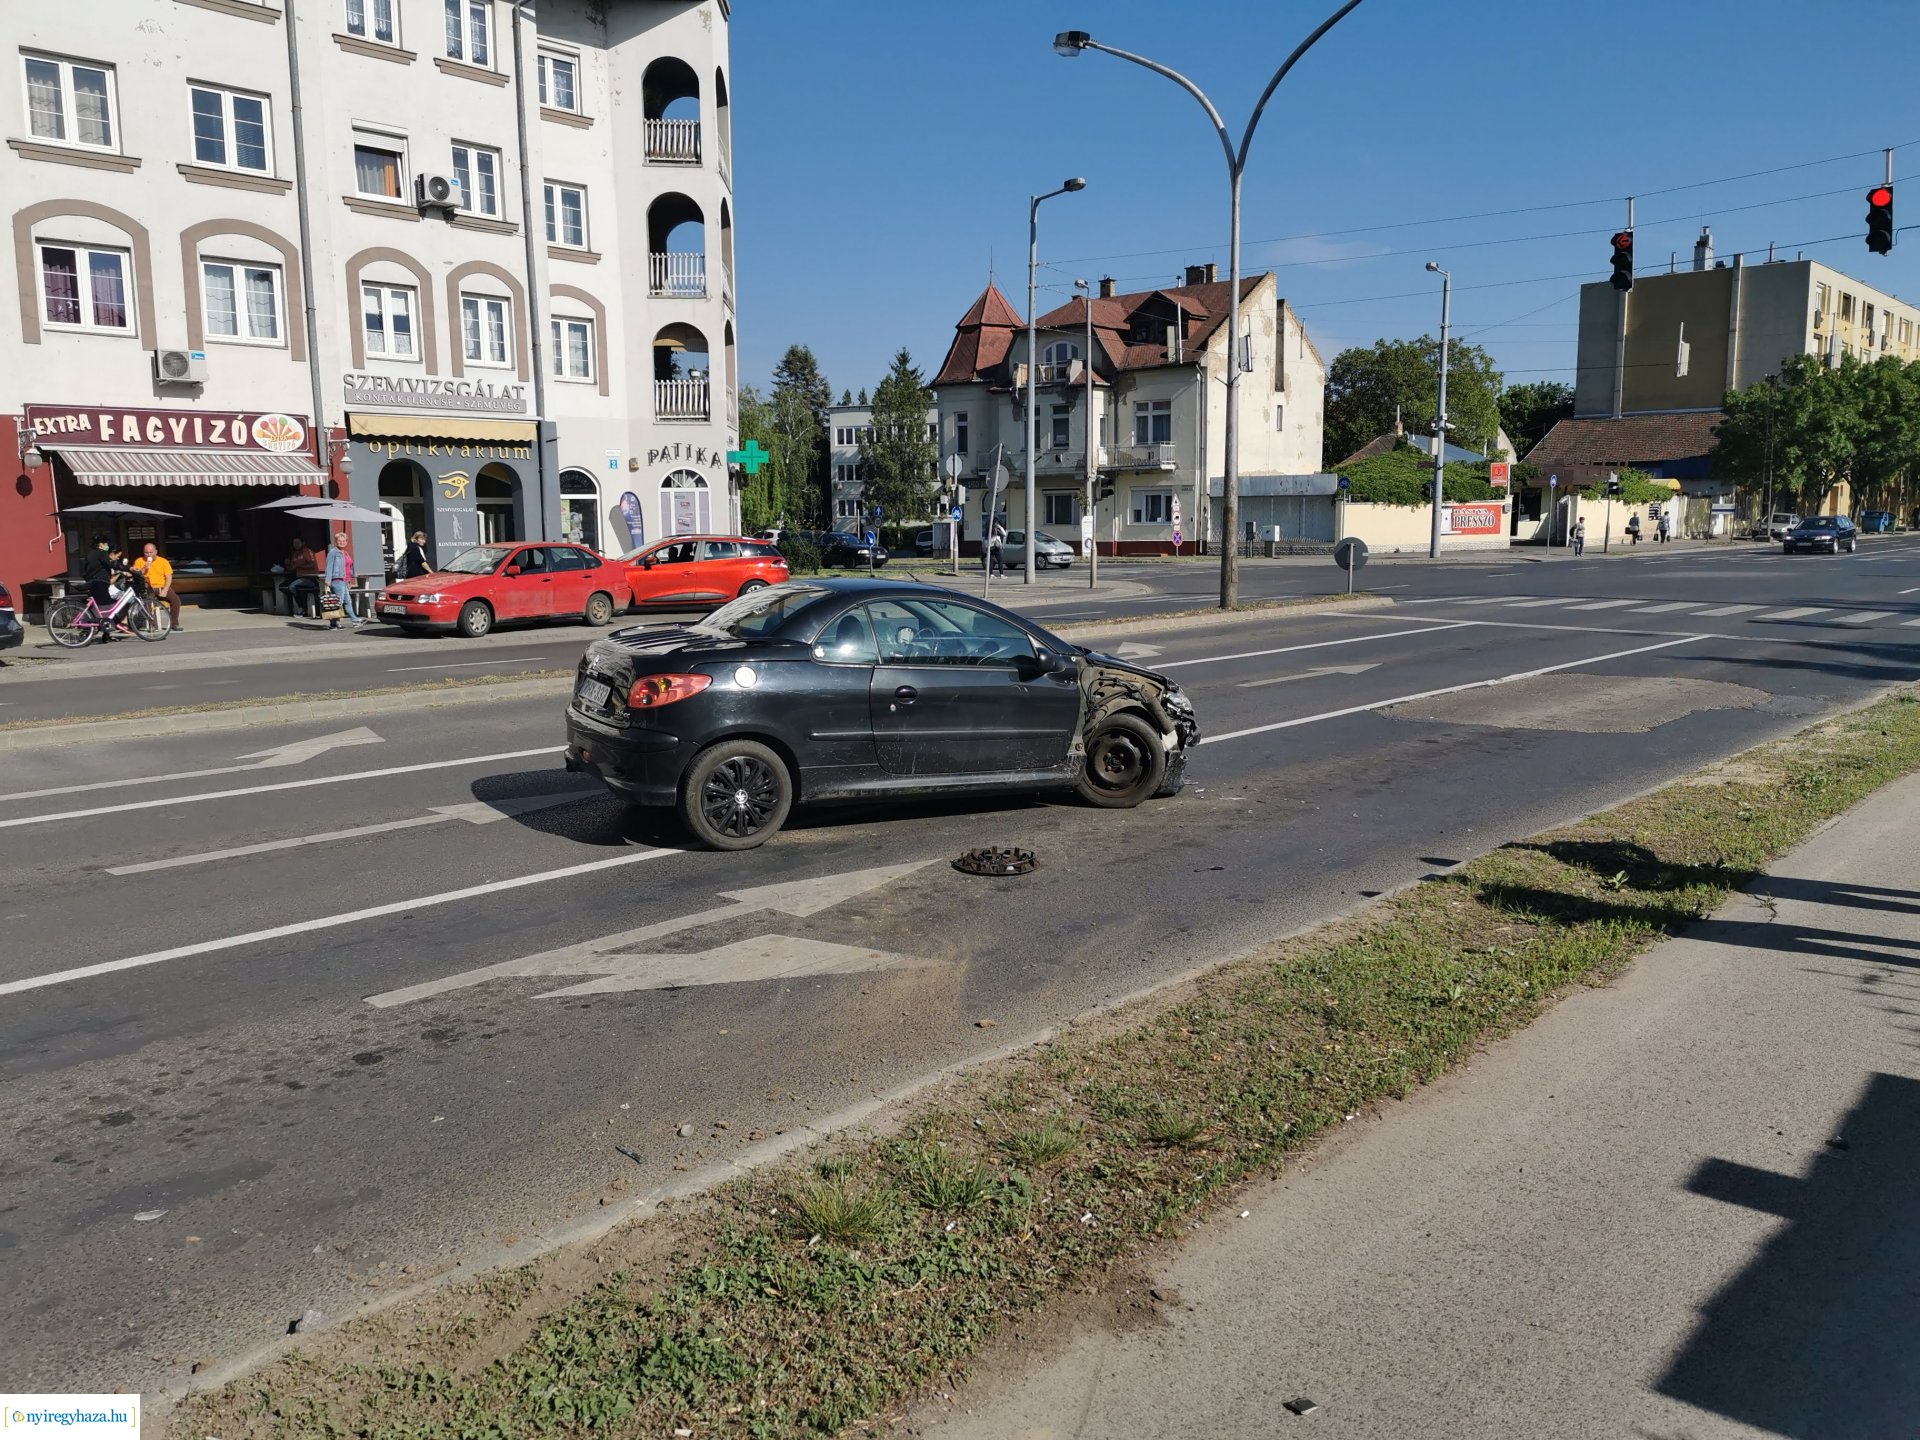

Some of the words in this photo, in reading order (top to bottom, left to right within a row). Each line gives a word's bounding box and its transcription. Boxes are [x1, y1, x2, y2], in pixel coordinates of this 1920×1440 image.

[343, 373, 525, 400] SZEMVIZSGÁLAT
[355, 392, 454, 408] KONTAKTLENCSE
[33, 413, 92, 436] EXTRA
[99, 414, 248, 446] FAGYIZÓ
[647, 442, 723, 469] PATIKA
[1453, 511, 1495, 528] PRESSZÓ
